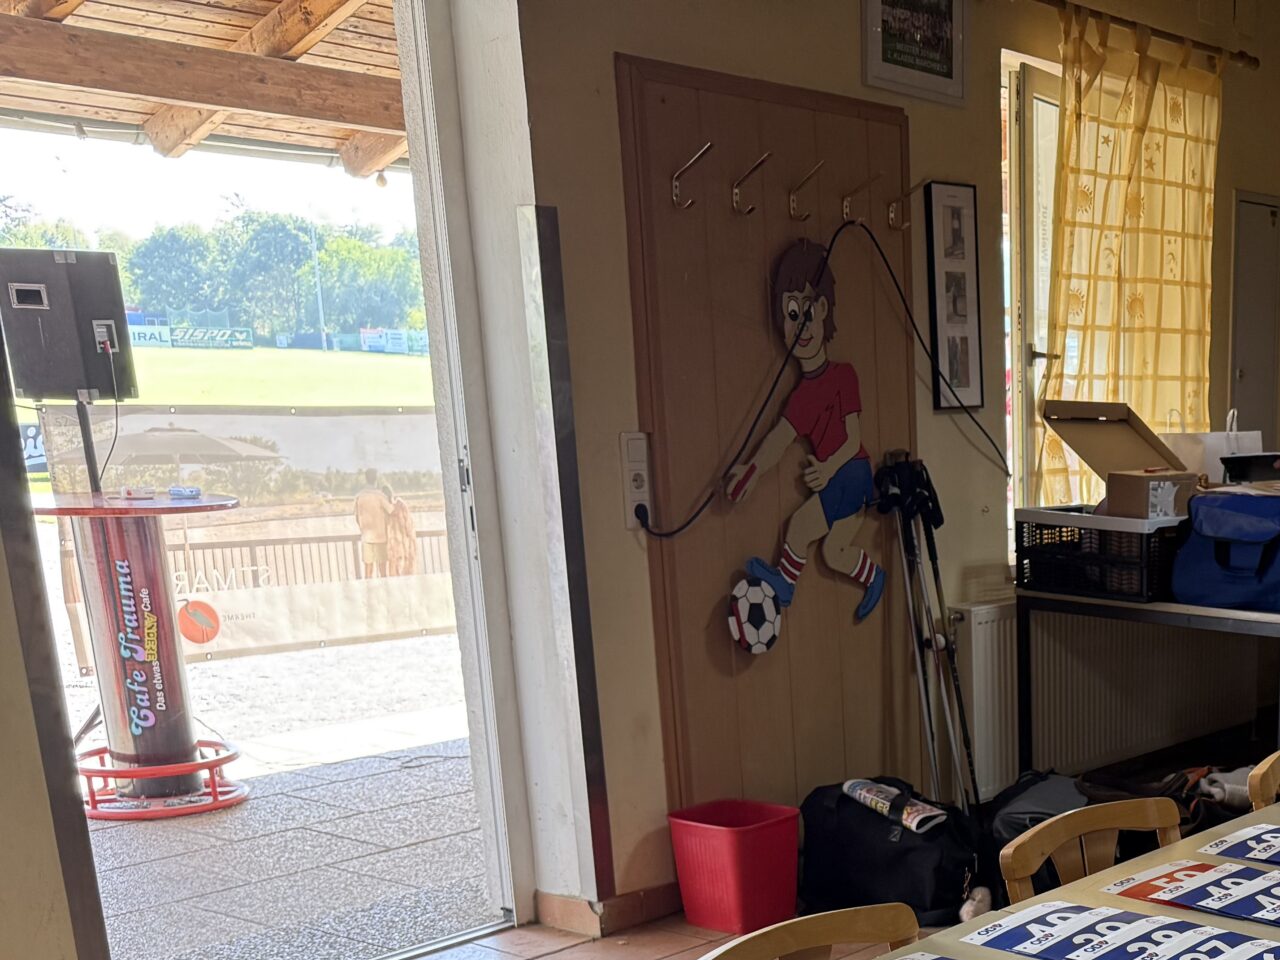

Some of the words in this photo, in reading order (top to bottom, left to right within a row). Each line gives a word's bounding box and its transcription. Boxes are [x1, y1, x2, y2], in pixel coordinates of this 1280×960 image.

[133, 331, 168, 343] IRAL
[115, 559, 146, 662] Trauma
[140, 588, 152, 612] Cafe
[152, 660, 163, 689] etwas
[126, 670, 156, 736] Cafe
[156, 689, 166, 711] Das
